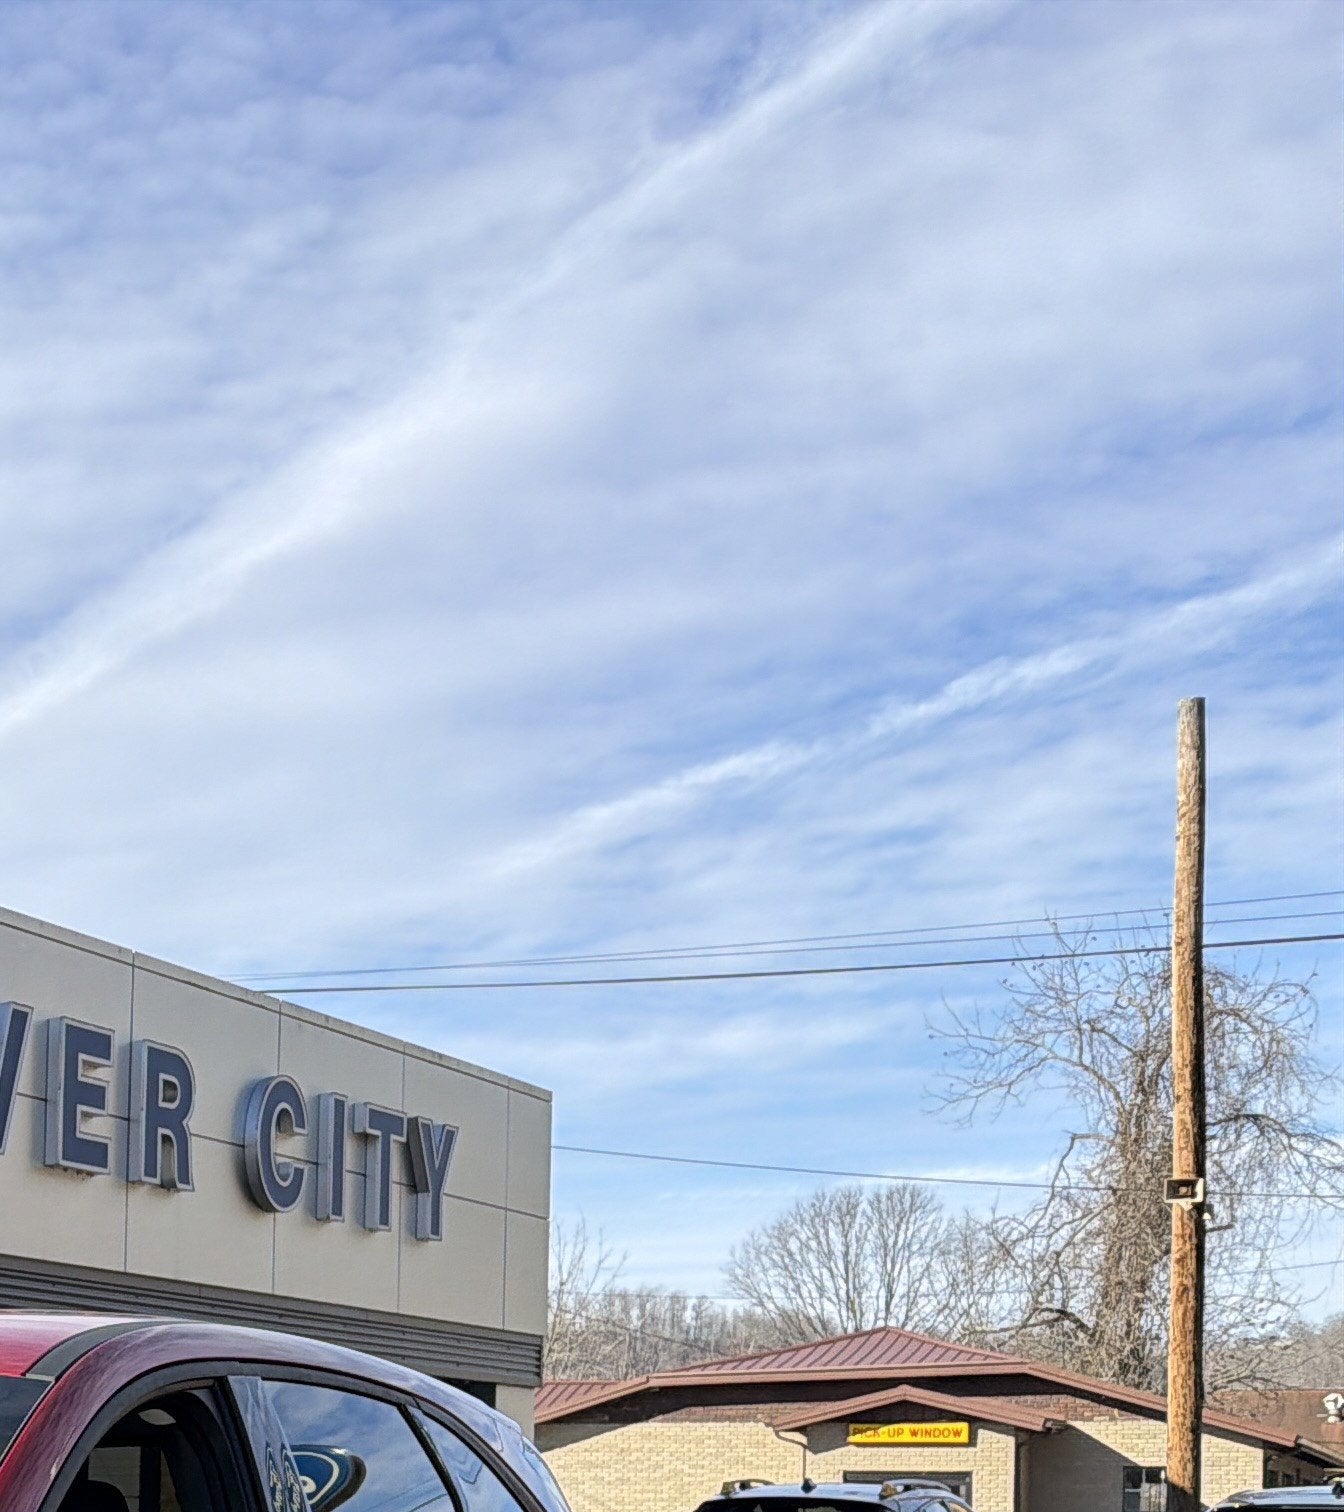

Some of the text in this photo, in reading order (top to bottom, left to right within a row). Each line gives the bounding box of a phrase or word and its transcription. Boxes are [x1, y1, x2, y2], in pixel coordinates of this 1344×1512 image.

[243, 1073, 459, 1241] CITY
[852, 1426, 963, 1439] PICK-UP WINDOW
